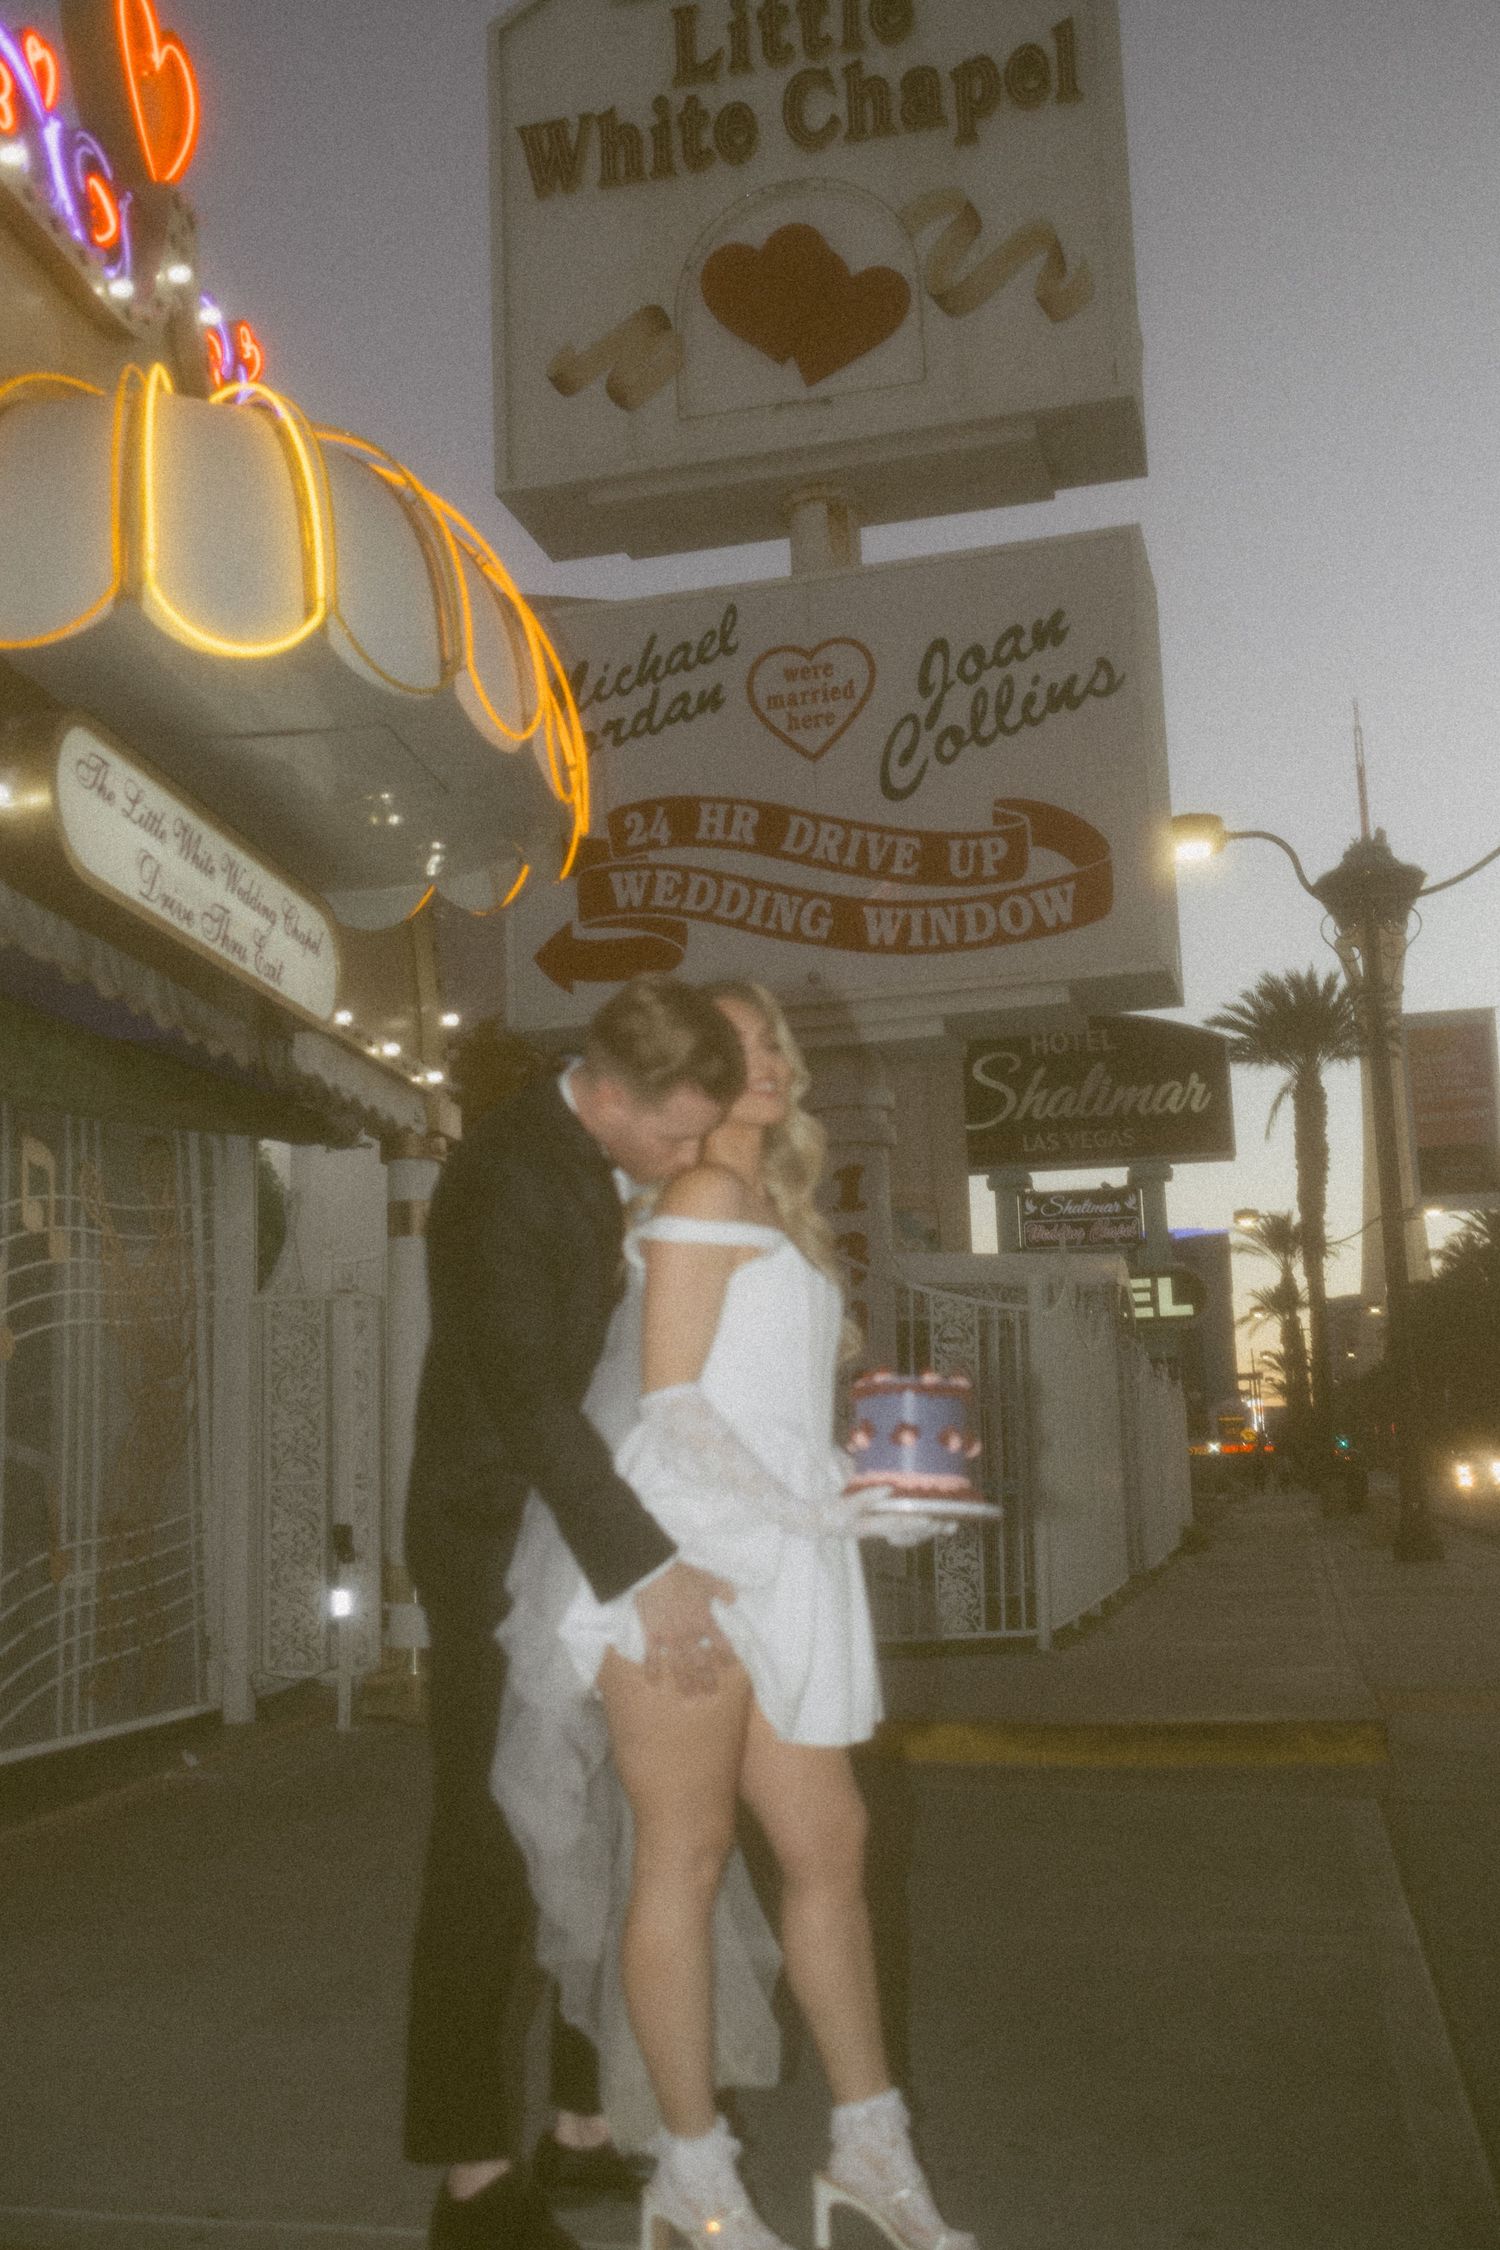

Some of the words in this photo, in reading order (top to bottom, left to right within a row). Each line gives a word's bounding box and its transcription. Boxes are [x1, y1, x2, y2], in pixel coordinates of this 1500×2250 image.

[671, 0, 915, 87] Little
[515, 92, 760, 200] White
[783, 16, 1084, 153] Chapel
[765, 679, 856, 710] married
[782, 659, 834, 683] were
[917, 608, 1071, 728] Joan
[785, 708, 836, 732] here
[879, 656, 1126, 801] Collins
[75, 752, 116, 807] The
[121, 777, 169, 846] Little
[172, 817, 216, 882] White
[221, 852, 279, 936] Wedding
[622, 806, 673, 849] 24
[695, 803, 762, 846] HR
[781, 823, 923, 876] DRIVE
[947, 835, 1011, 880] UP
[138, 850, 193, 928] Drive
[609, 871, 835, 942] WEDDING
[865, 883, 1077, 947] WINDOW
[1030, 1031, 1116, 1055] HOTEL
[966, 1050, 1213, 1131] Shalimar
[1022, 1134, 1060, 1152] LAS
[1063, 1128, 1136, 1150] VEGAS
[1040, 1195, 1122, 1218] Shalimar
